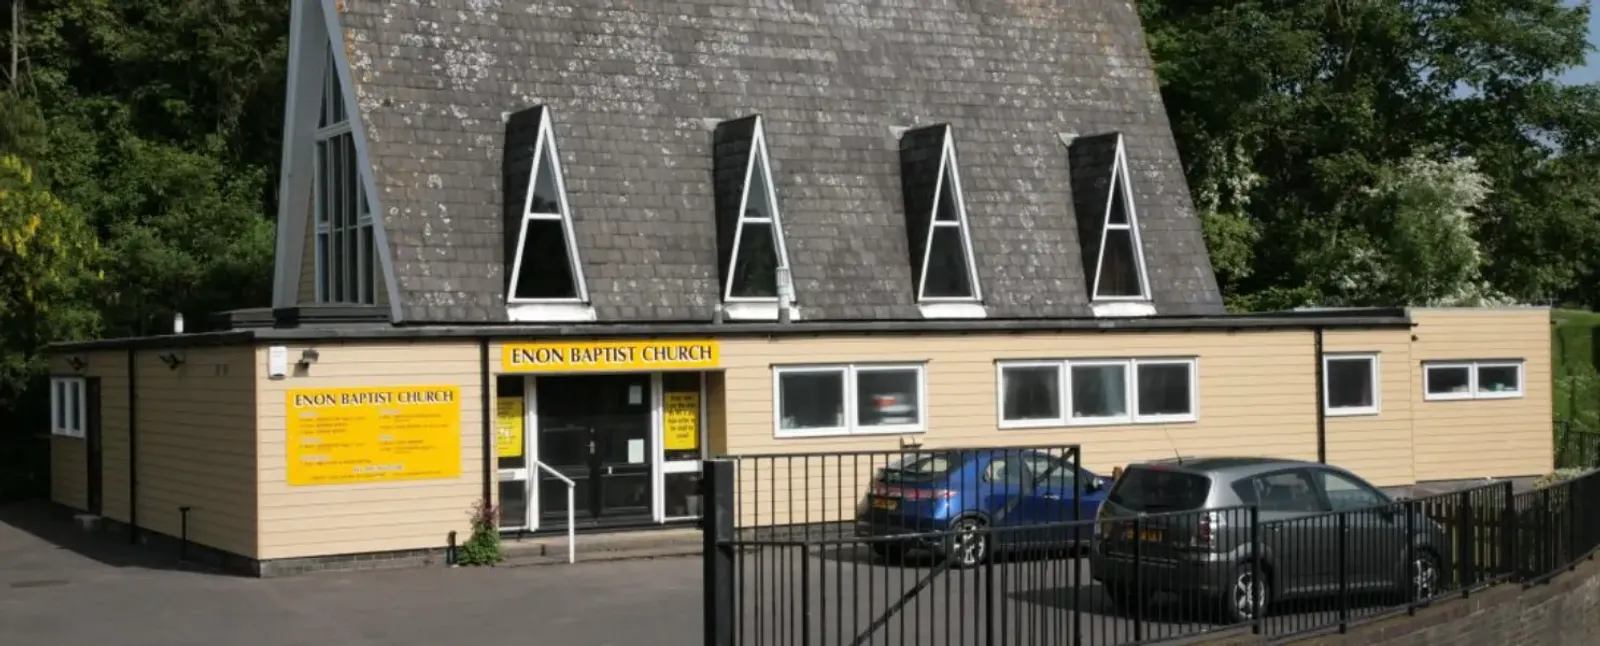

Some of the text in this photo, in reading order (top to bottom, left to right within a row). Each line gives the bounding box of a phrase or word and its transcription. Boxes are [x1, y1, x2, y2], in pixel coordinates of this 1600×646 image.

[512, 345, 712, 364] ENON BAPTIST CHURCH
[295, 390, 454, 406] ENON BAPTIST CHURCH
